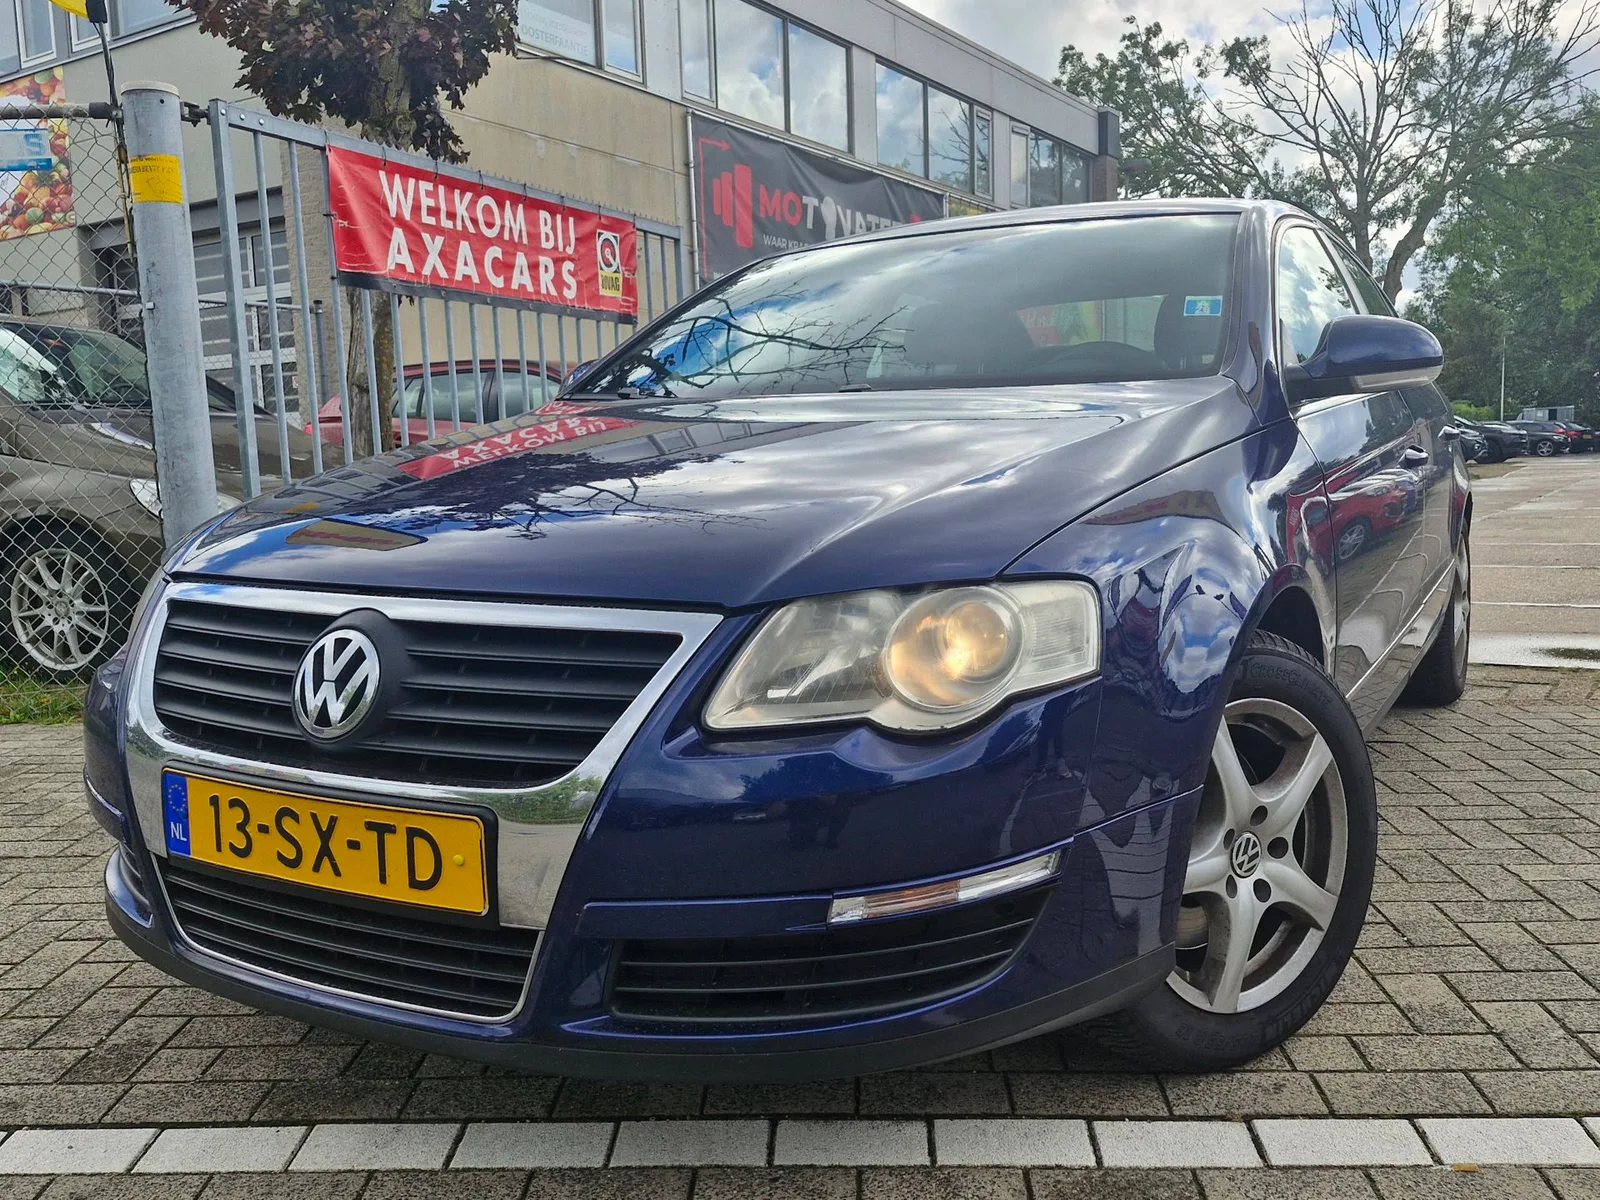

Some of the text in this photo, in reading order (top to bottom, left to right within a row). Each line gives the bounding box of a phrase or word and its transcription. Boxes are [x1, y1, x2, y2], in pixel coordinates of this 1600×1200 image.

[378, 170, 575, 254] WELKOM BIJ
[763, 234, 787, 249] WAAR
[387, 227, 577, 299] AXACARS
[170, 821, 187, 842] NL
[208, 794, 443, 891] 13-SX-TD
